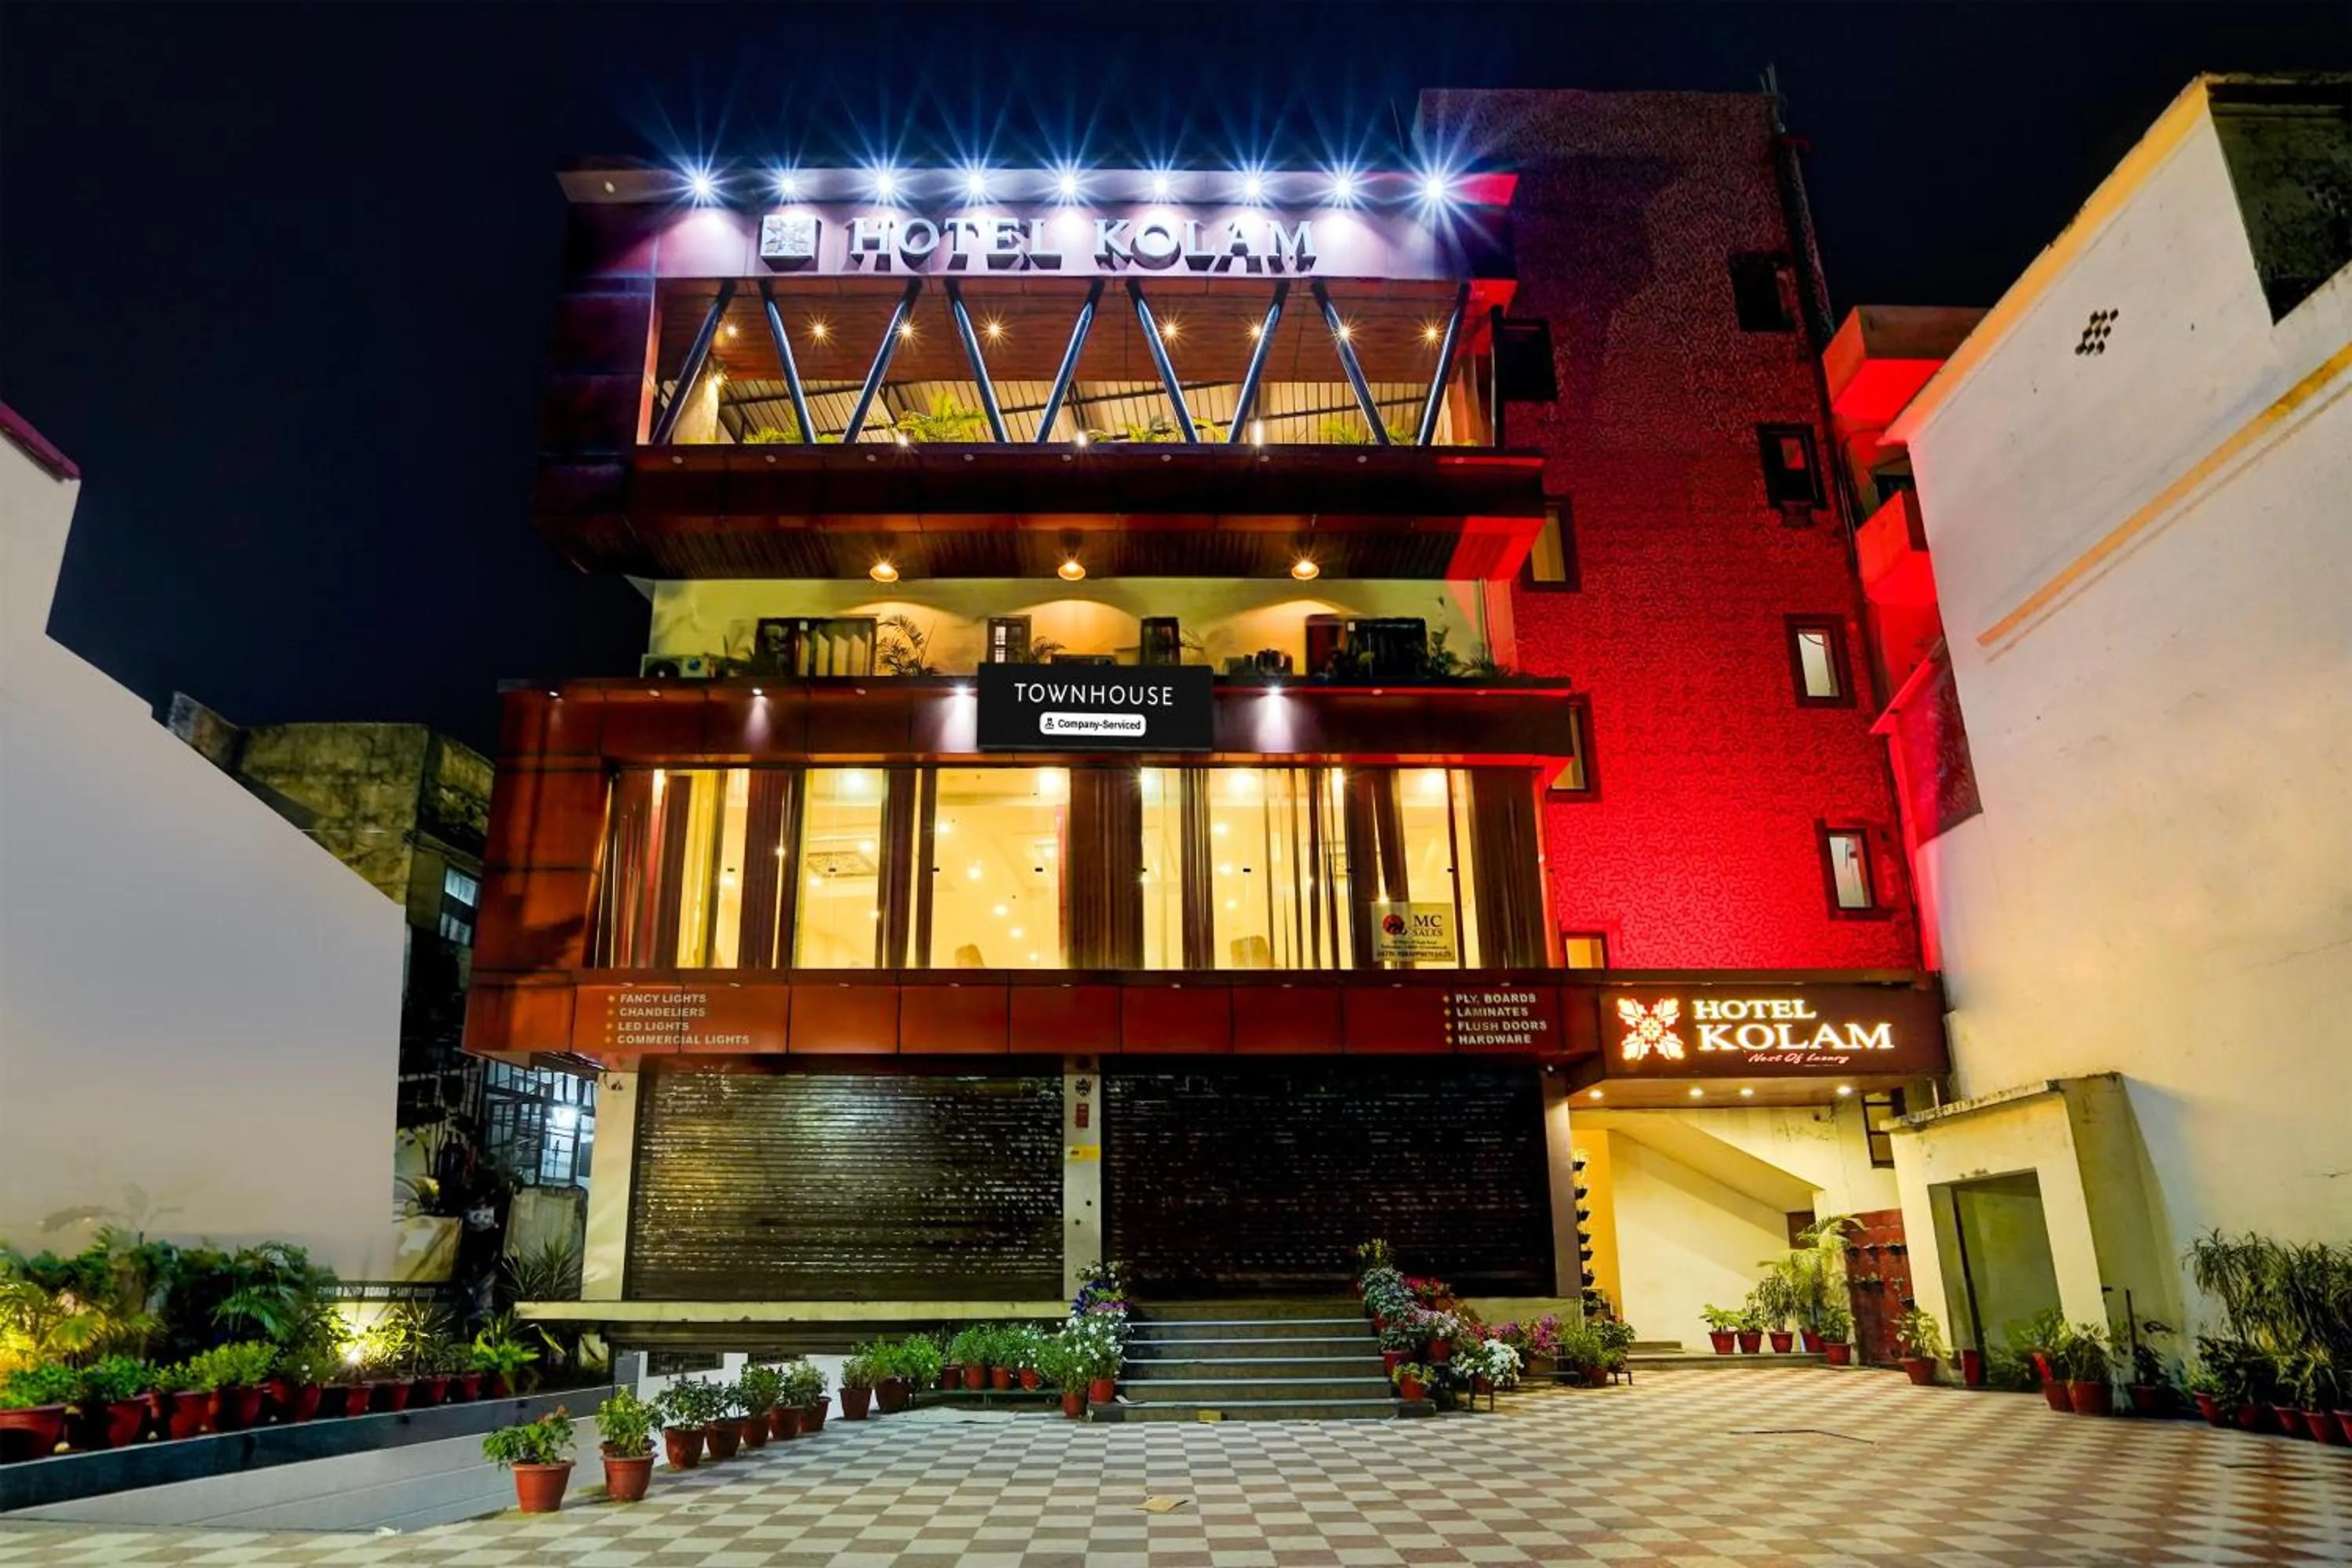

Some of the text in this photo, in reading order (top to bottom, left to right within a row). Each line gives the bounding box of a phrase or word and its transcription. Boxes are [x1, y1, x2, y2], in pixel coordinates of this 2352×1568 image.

[850, 216, 1316, 263] HOTEL KOLAM
[1014, 683, 1174, 705] TOWNHOUSE
[1058, 719, 1141, 730] Company-Serviced
[1414, 915, 1442, 927] MC
[620, 994, 706, 1003] FANCY LIGHTS
[1484, 994, 1537, 1003] BOARDS
[619, 1007, 706, 1017] CHANDELIERS
[1457, 1007, 1529, 1017] LAMINATES
[1693, 1000, 1817, 1020] HOTEL
[618, 1022, 690, 1031] LED LIGHTS
[1457, 1021, 1547, 1031] FLUSH DOORS
[618, 1036, 750, 1044] COMMERCIAL LIGHTS
[1459, 1035, 1531, 1044] HARDWARE
[1697, 1022, 1894, 1051] KOLAM
[1784, 1053, 1803, 1064] Of
